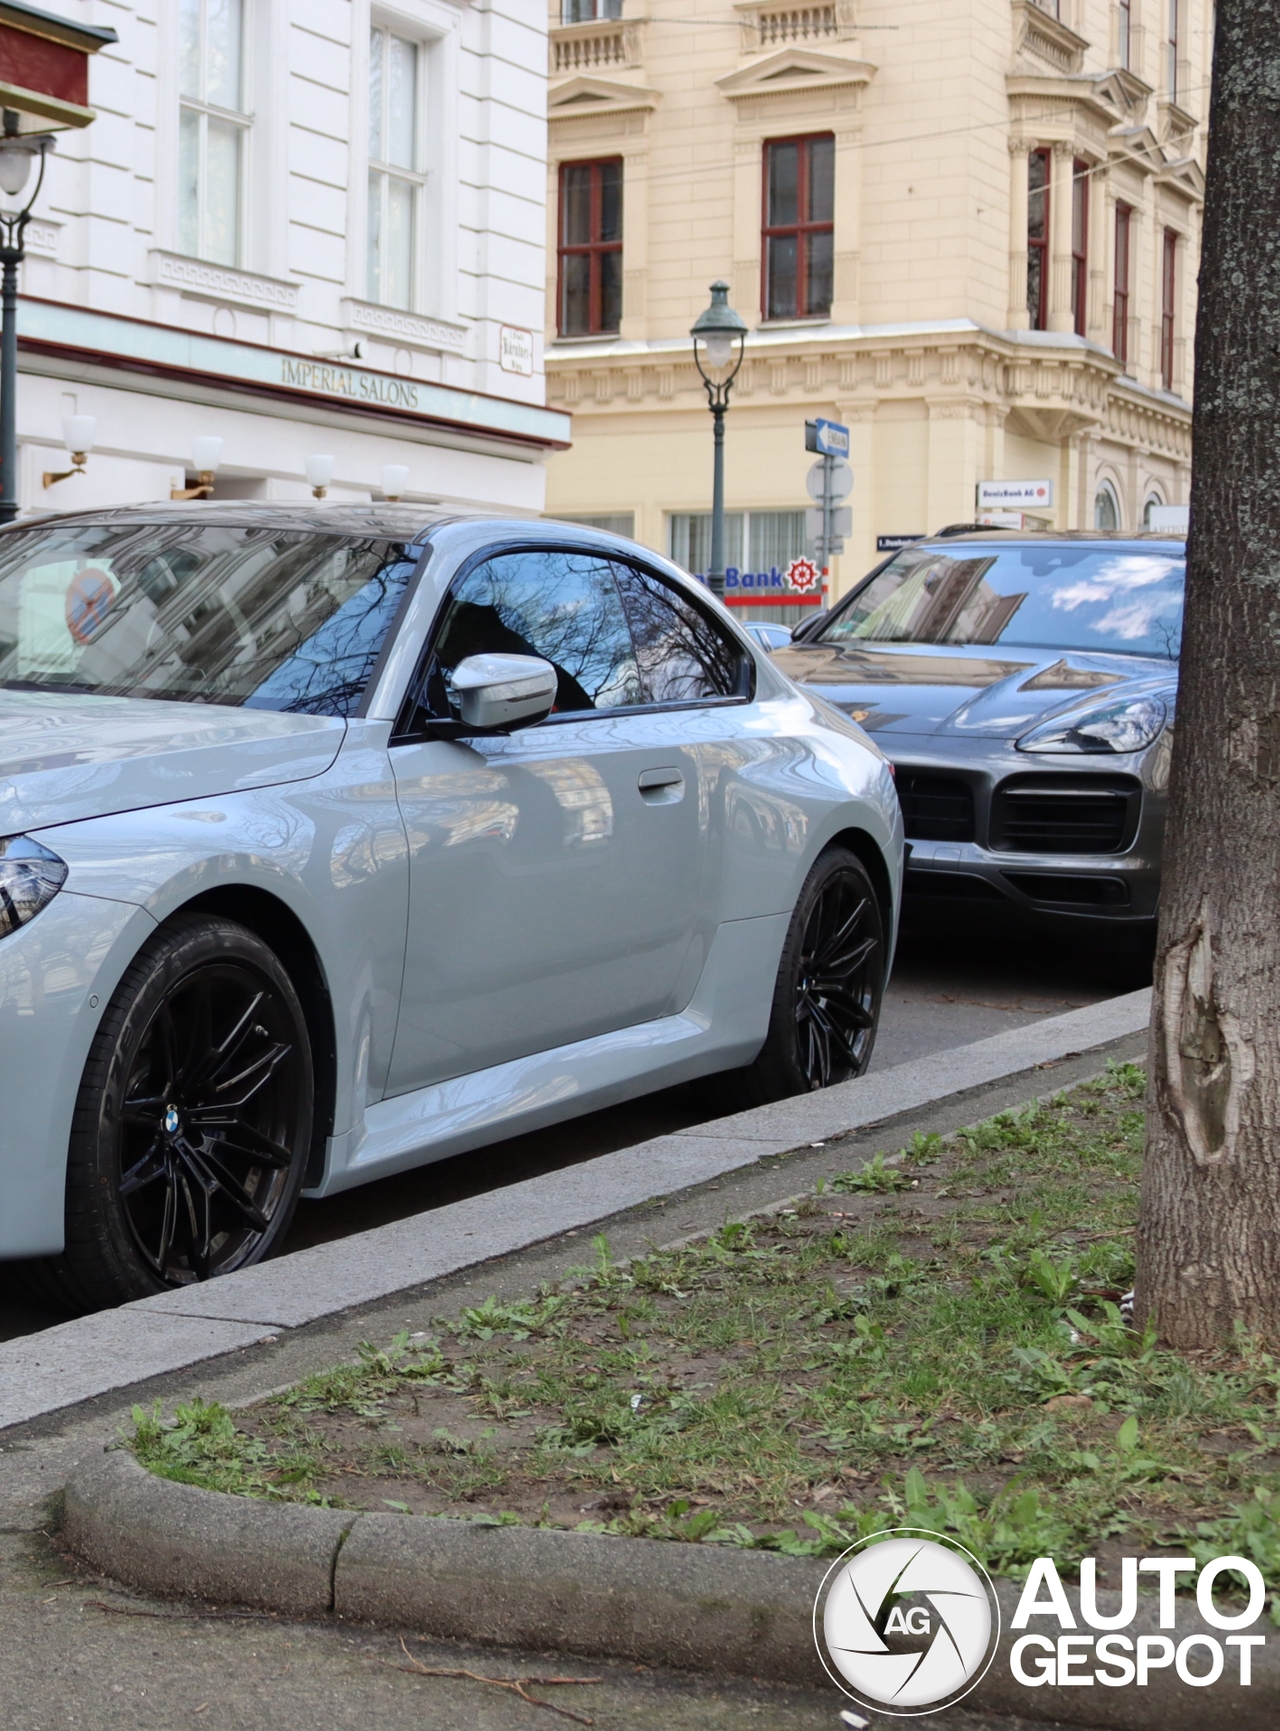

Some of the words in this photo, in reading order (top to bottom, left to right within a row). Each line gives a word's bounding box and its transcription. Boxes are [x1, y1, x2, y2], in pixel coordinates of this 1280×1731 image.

[281, 359, 357, 396] IMPERIAL
[360, 374, 419, 409] SALONS
[983, 488, 1022, 497] DenizBank
[1024, 488, 1035, 497] AG
